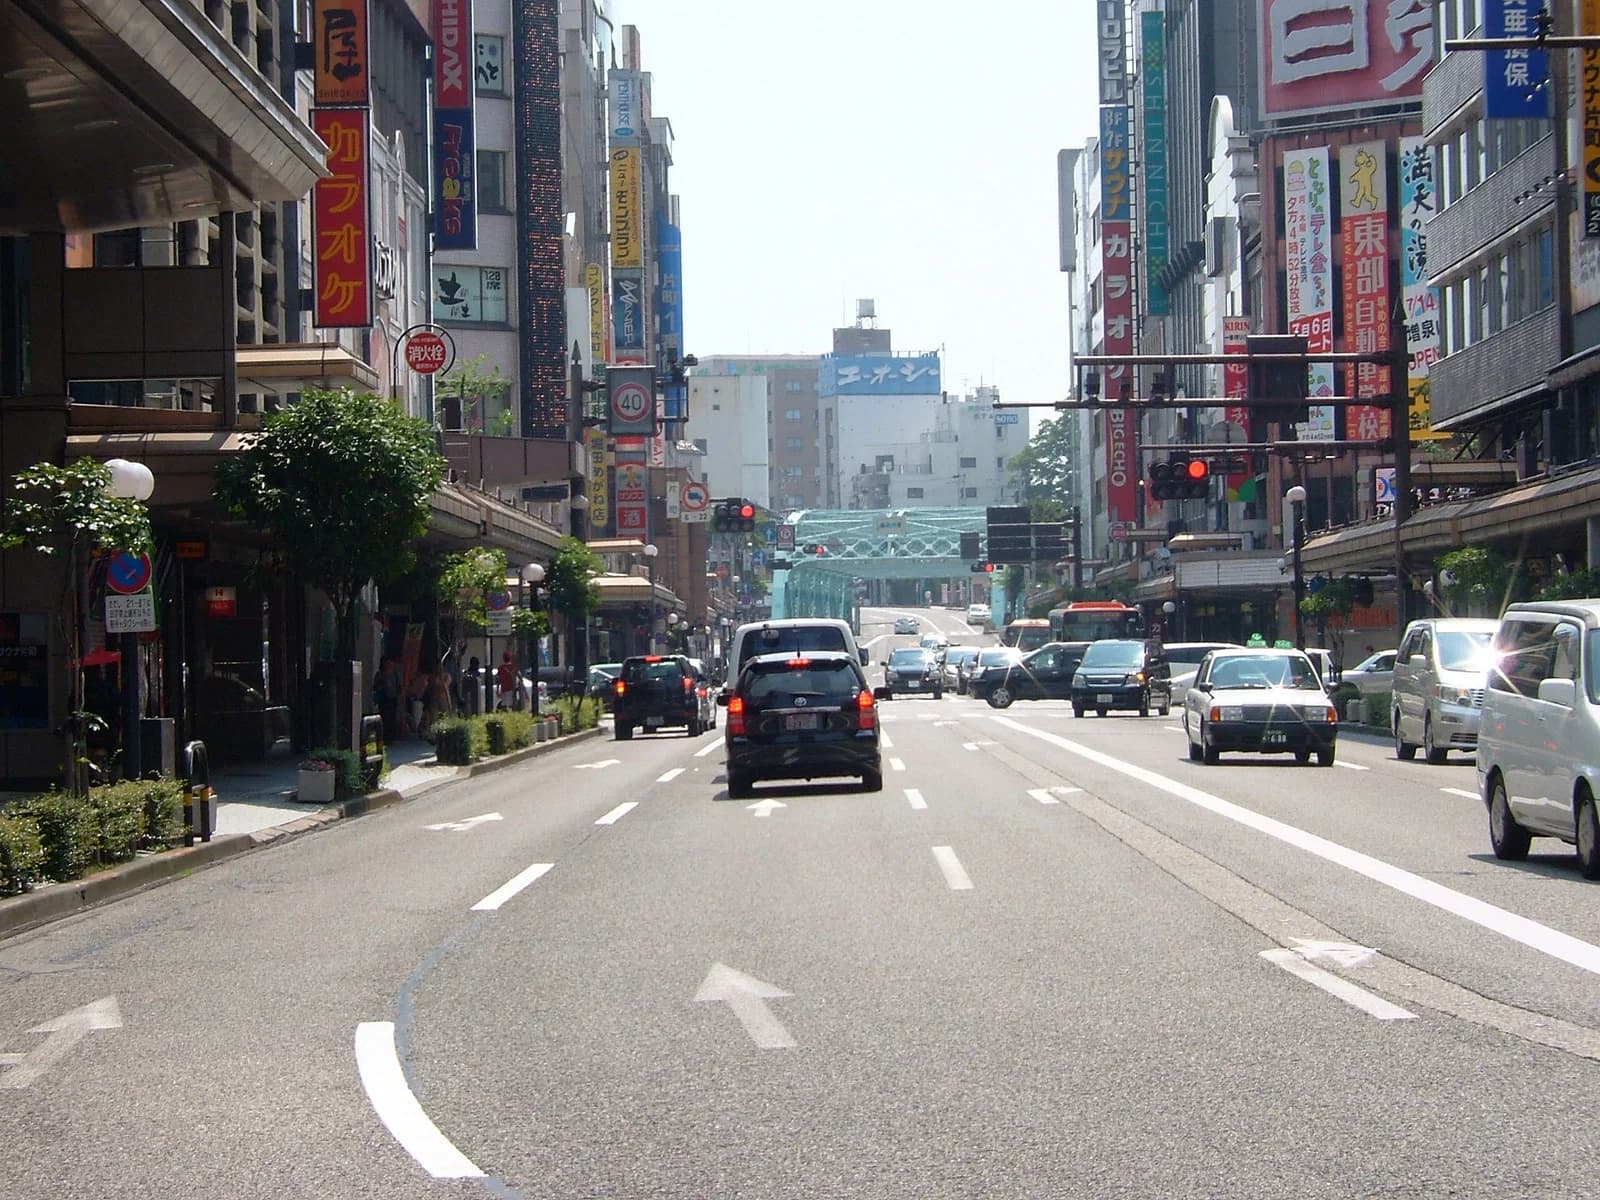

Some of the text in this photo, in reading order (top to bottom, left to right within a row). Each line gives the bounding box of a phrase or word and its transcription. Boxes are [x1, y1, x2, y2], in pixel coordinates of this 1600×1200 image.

[1104, 149, 1127, 217] サウナ
[321, 121, 362, 315] カラオケ
[408, 344, 444, 362] 消火栓
[621, 393, 642, 411] 40
